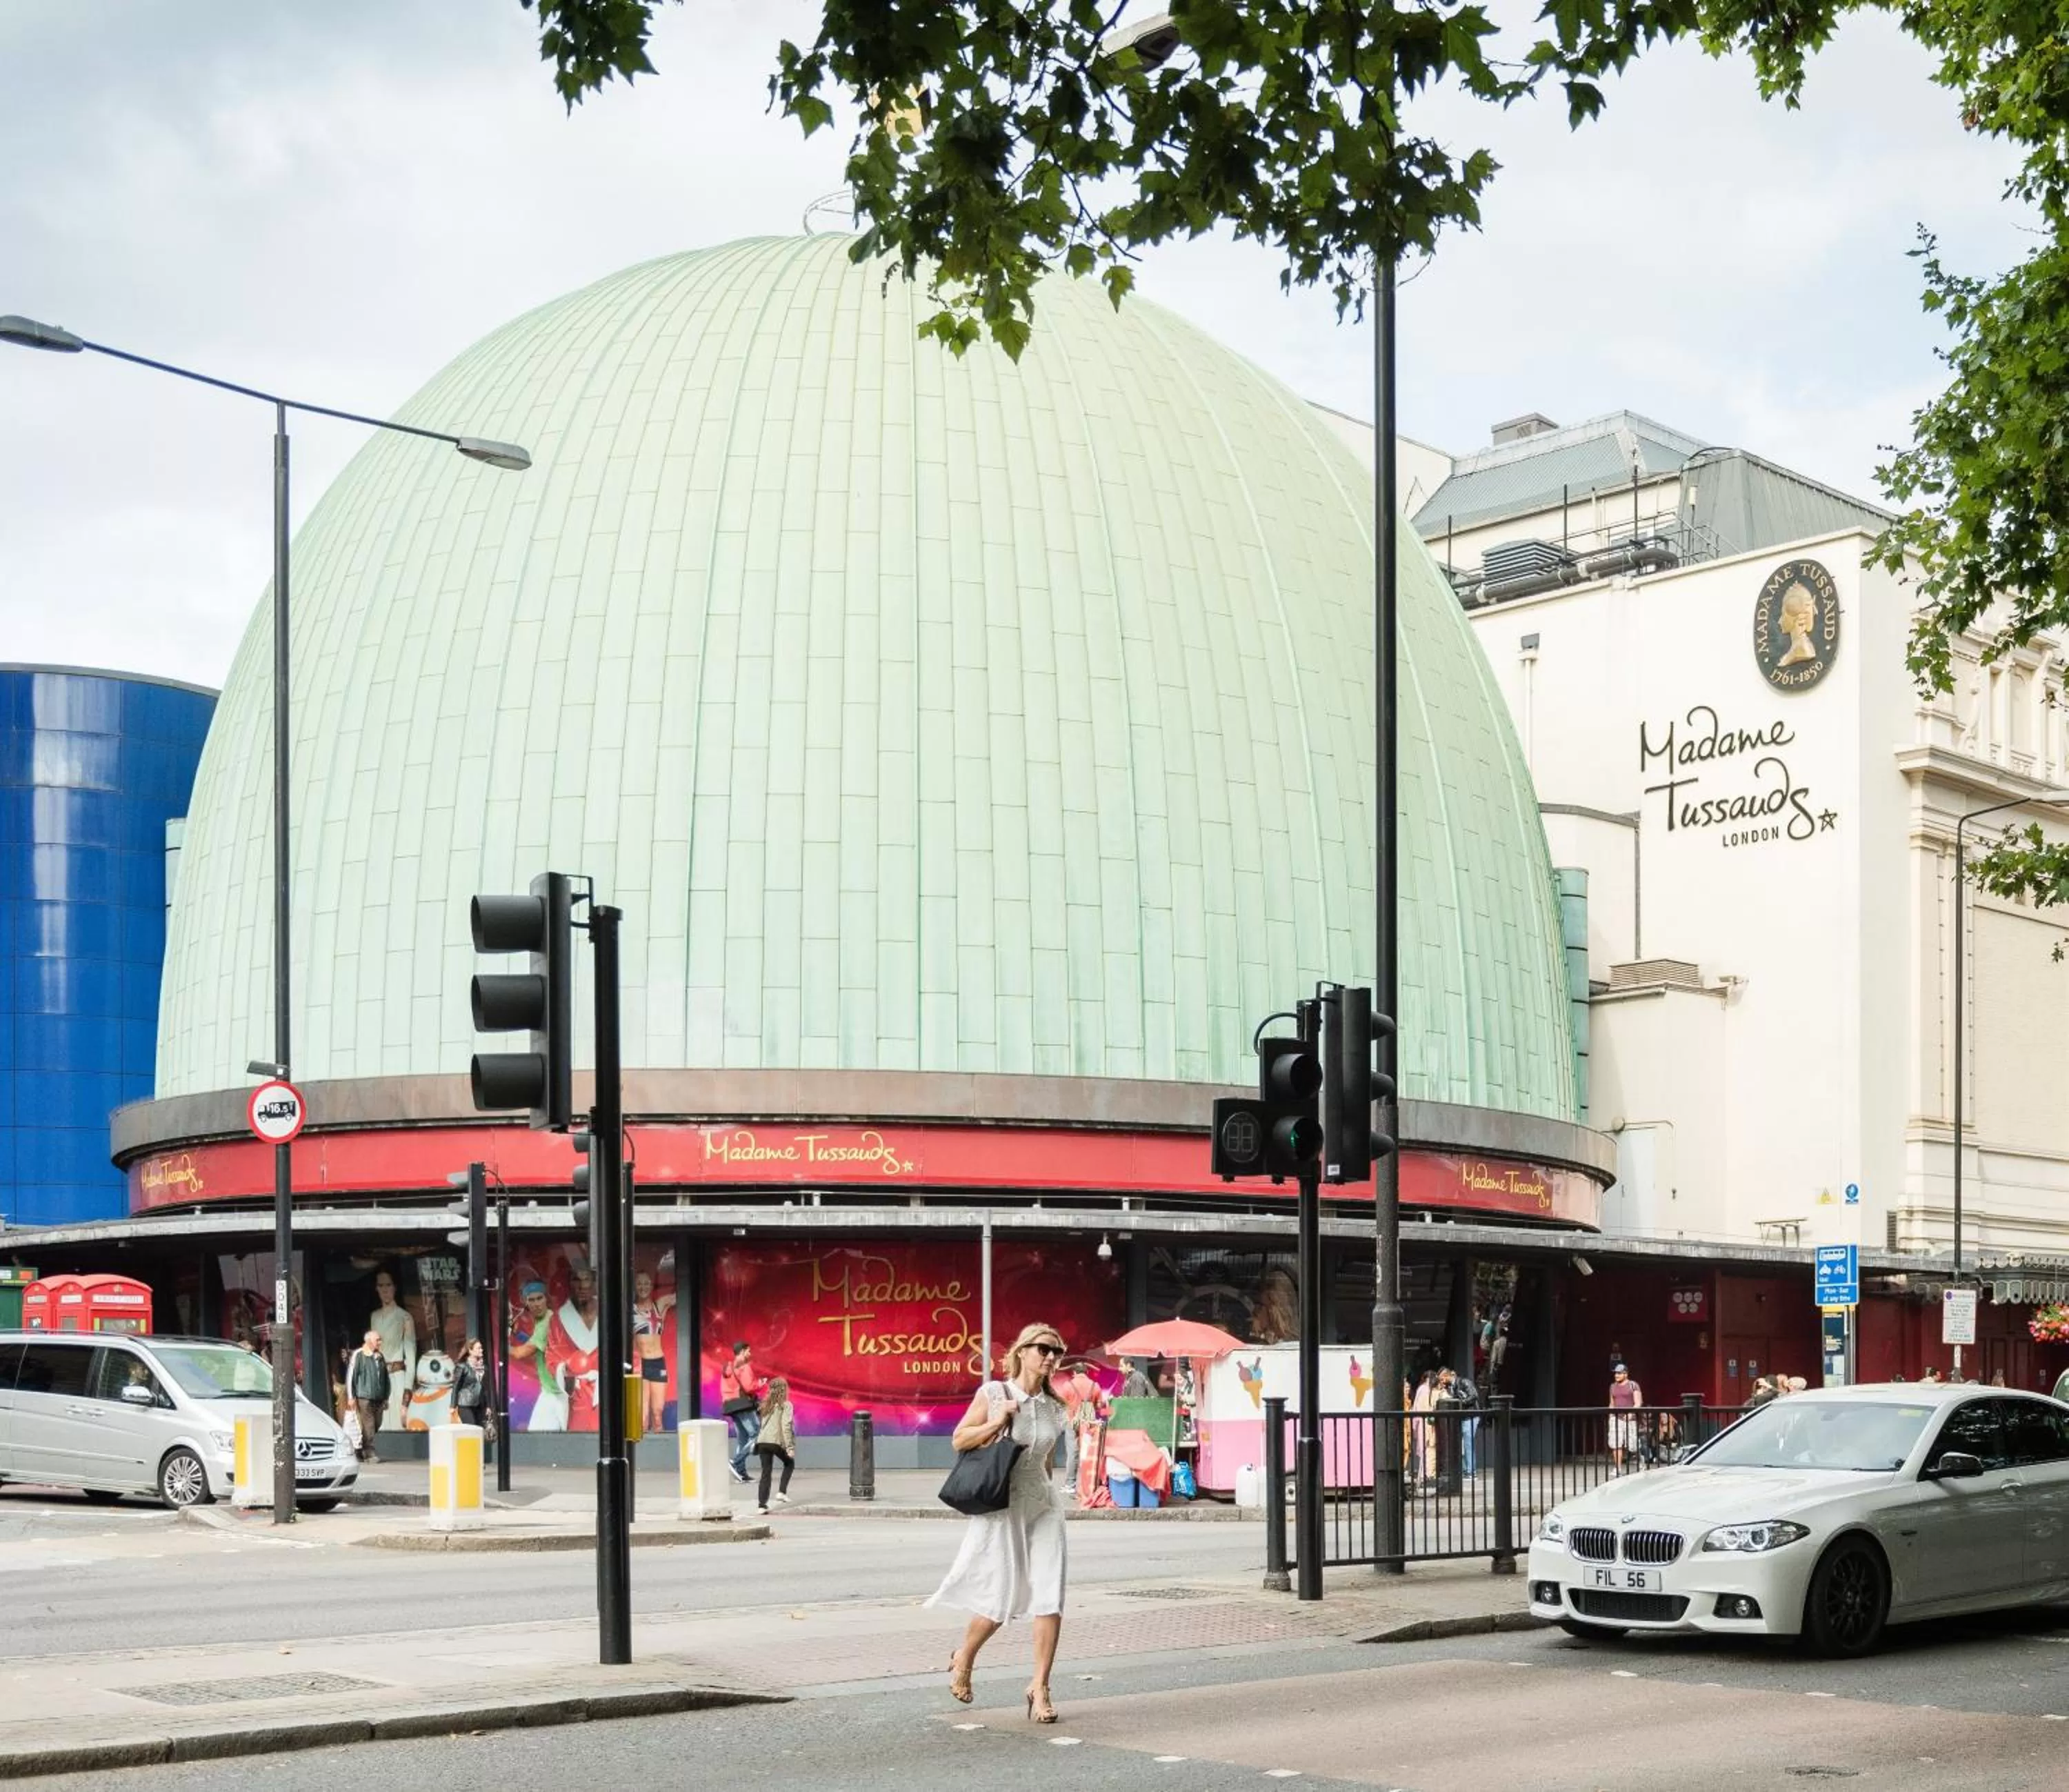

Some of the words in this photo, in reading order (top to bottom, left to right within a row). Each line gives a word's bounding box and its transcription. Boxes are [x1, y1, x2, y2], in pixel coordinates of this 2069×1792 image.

[1757, 566, 1795, 653] MADAME
[1799, 563, 1836, 641] TUSSAUD
[1769, 661, 1823, 686] 1761-1850
[1641, 706, 1795, 775] Madame
[1644, 757, 1815, 841] Tussauds
[1722, 826, 1779, 848] LONDON
[705, 1131, 801, 1164] Madame
[794, 1131, 901, 1175] Tussauds
[1463, 1162, 1508, 1191] Madame
[813, 1257, 971, 1308] Madame
[818, 1307, 994, 1376] Tussauds
[903, 1361, 961, 1374] LONDON
[1596, 1569, 1617, 1586] FIL
[1627, 1571, 1646, 1588] 56
